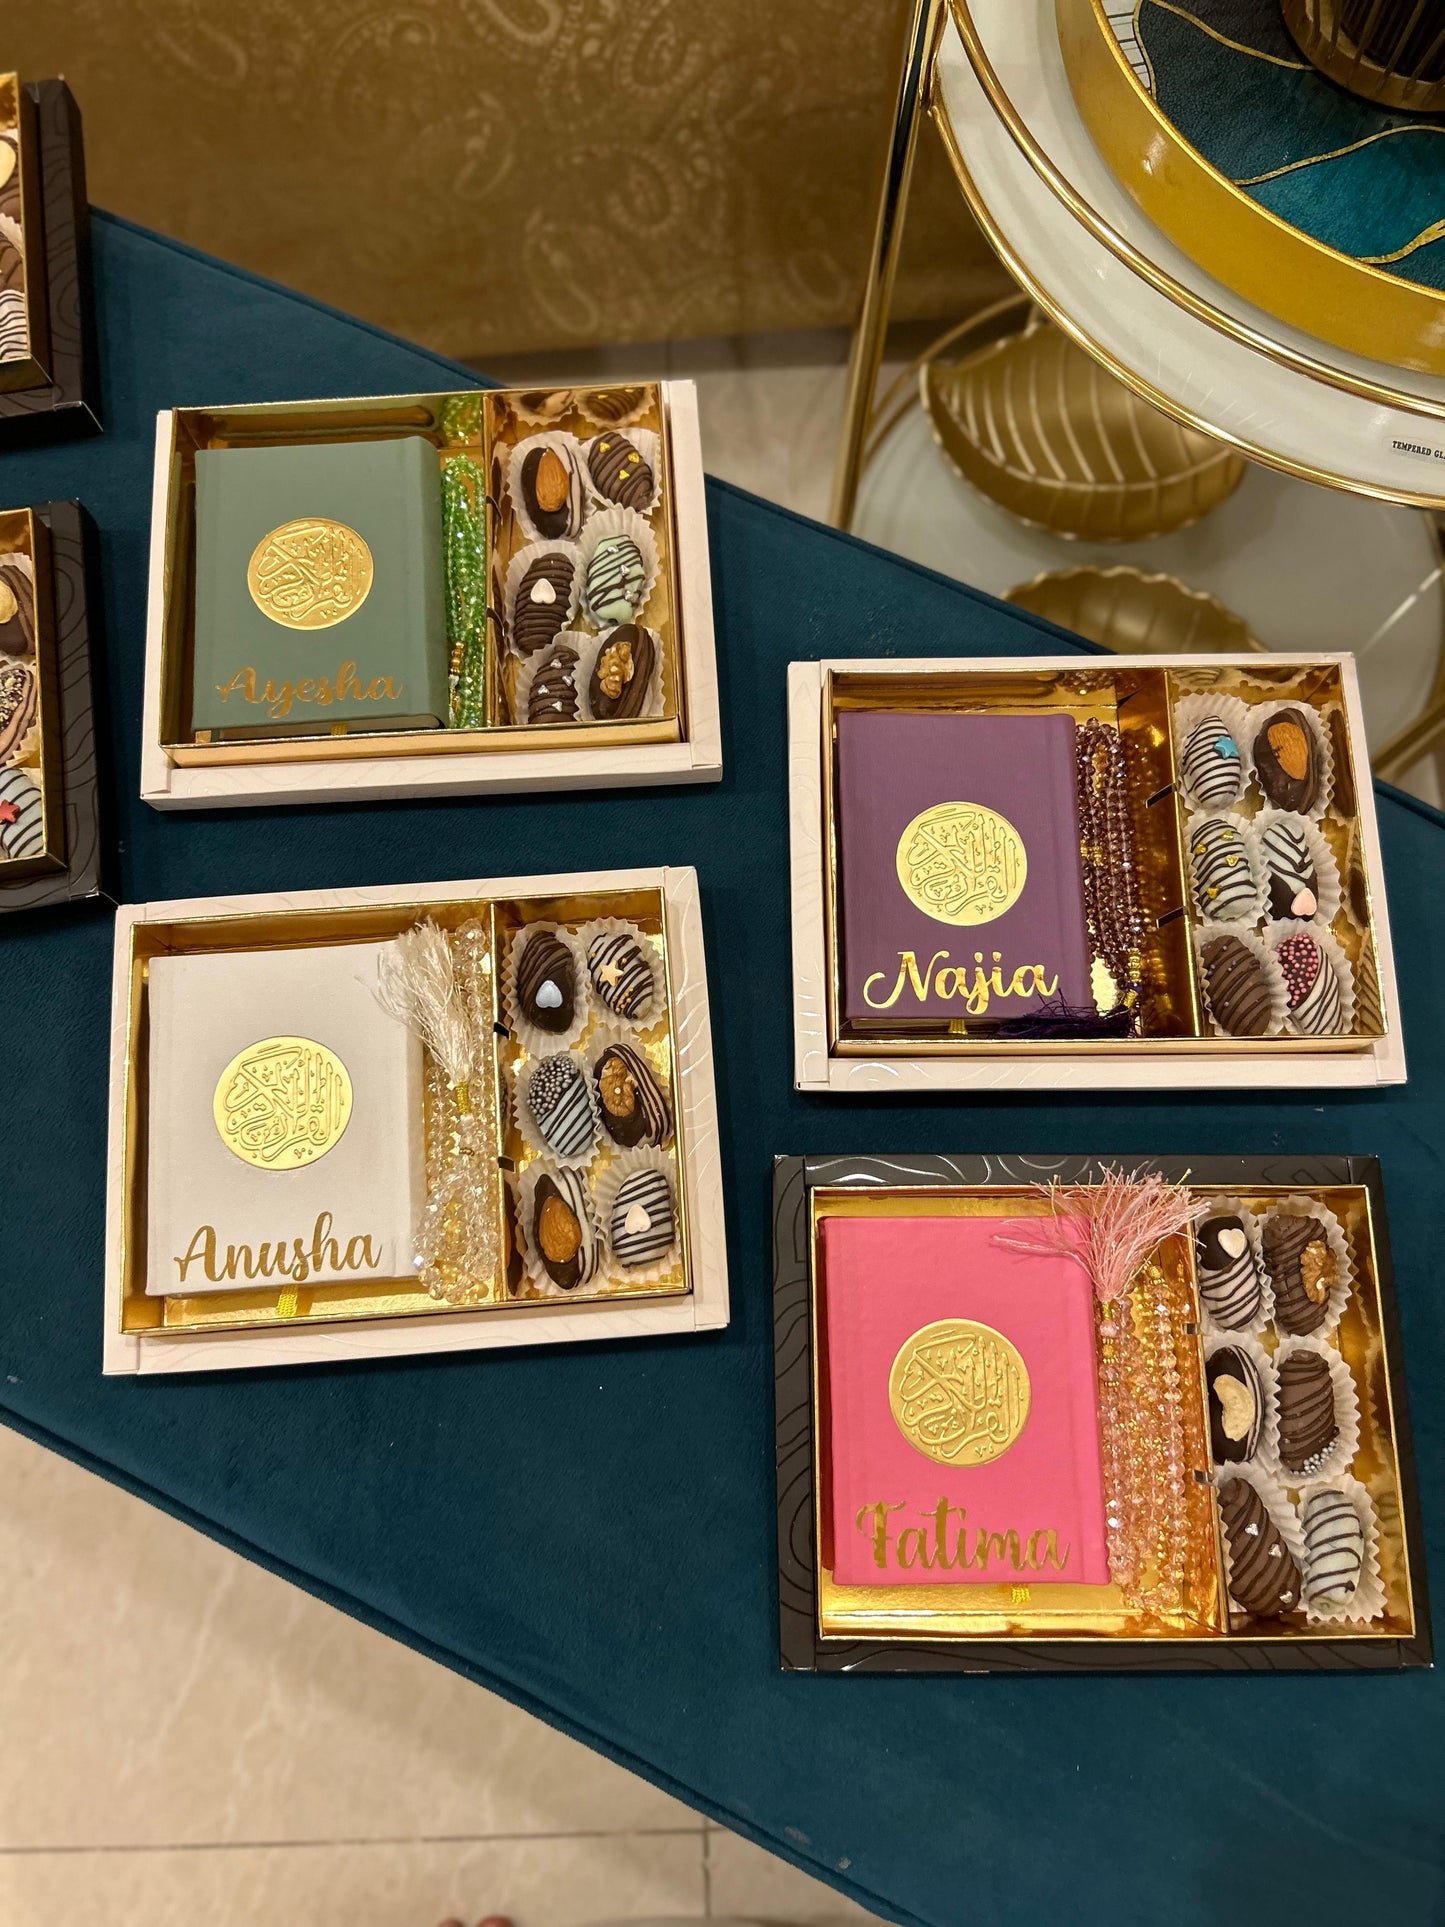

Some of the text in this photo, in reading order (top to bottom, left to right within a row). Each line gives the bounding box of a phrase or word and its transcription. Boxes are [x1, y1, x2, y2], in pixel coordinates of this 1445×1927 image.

[1392, 440, 1445, 460] TEMPERED GL
[215, 658, 404, 719] Ayesha
[863, 951, 1059, 1015] Najia
[173, 1211, 383, 1282] Anusha
[856, 1496, 1070, 1571] Fatima
